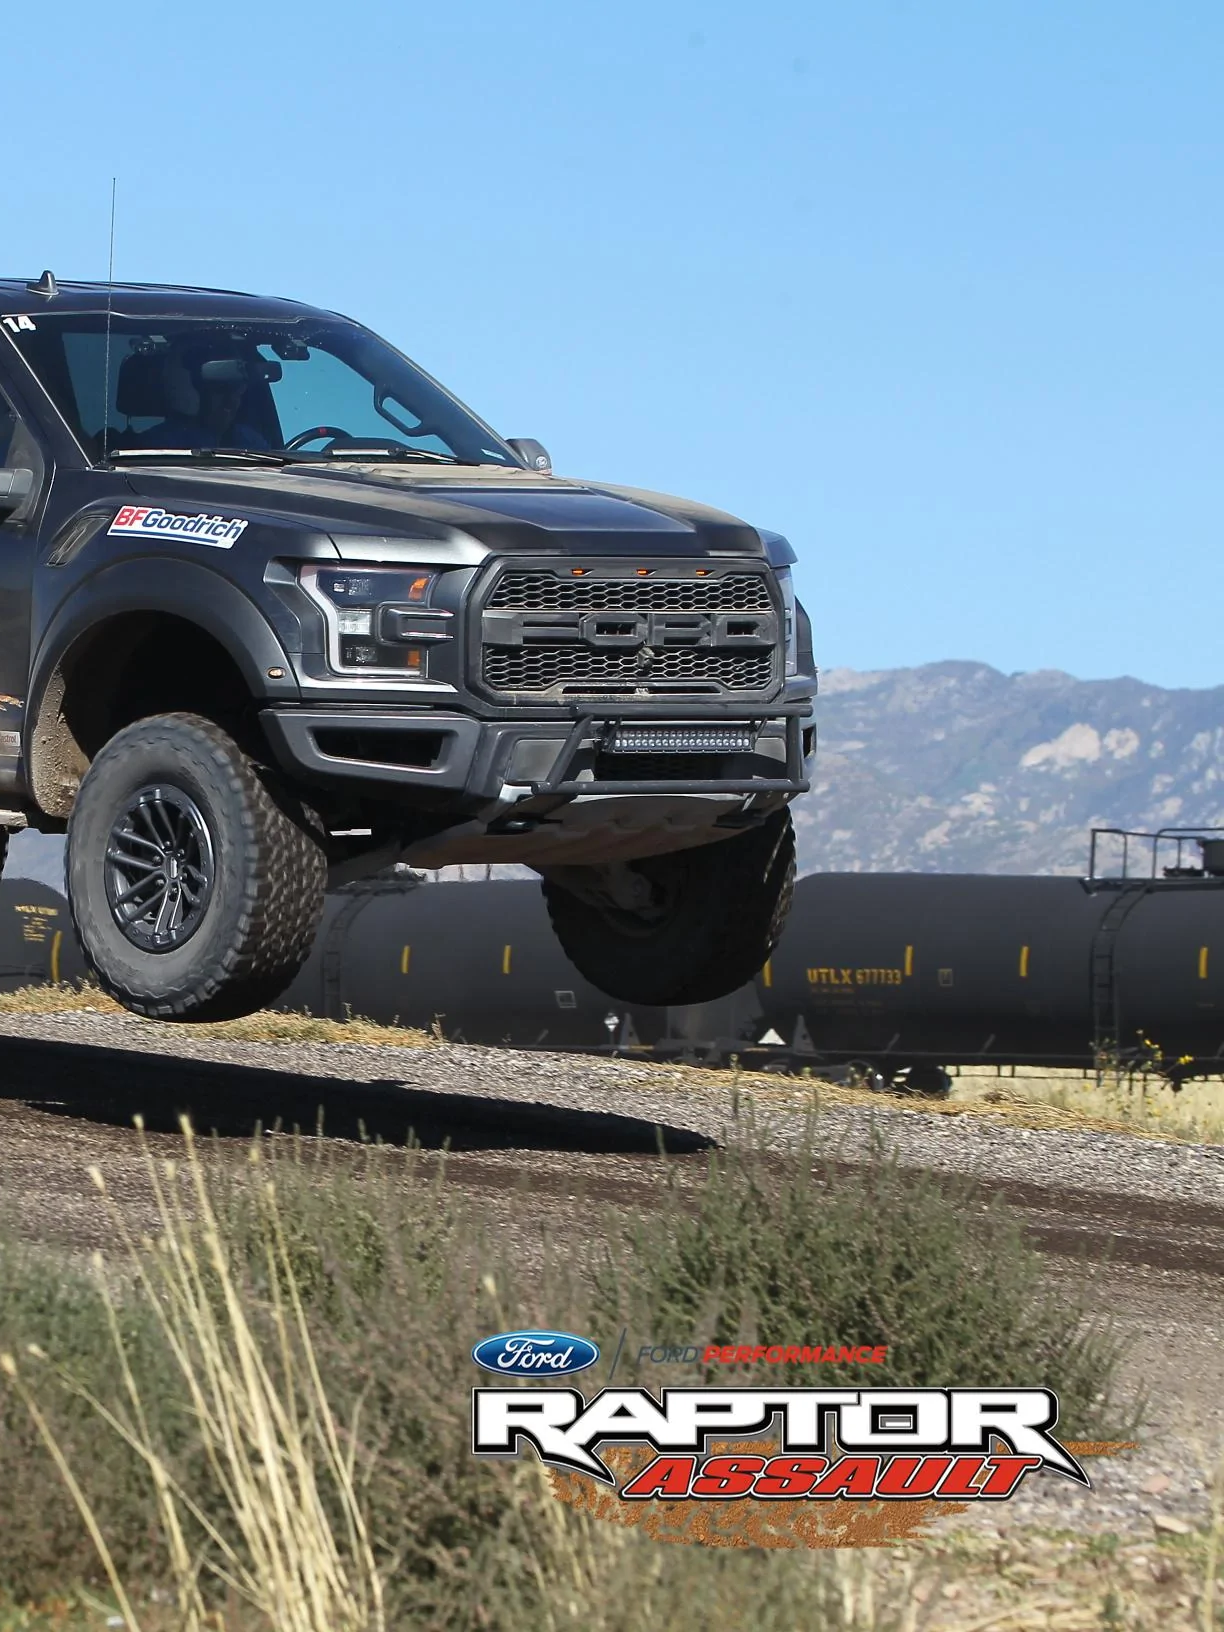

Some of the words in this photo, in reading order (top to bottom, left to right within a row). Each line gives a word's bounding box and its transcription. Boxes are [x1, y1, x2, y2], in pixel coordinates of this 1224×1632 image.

[2, 315, 37, 333] 14
[113, 507, 244, 539] BFGoodrich
[807, 967, 853, 985] UTLX
